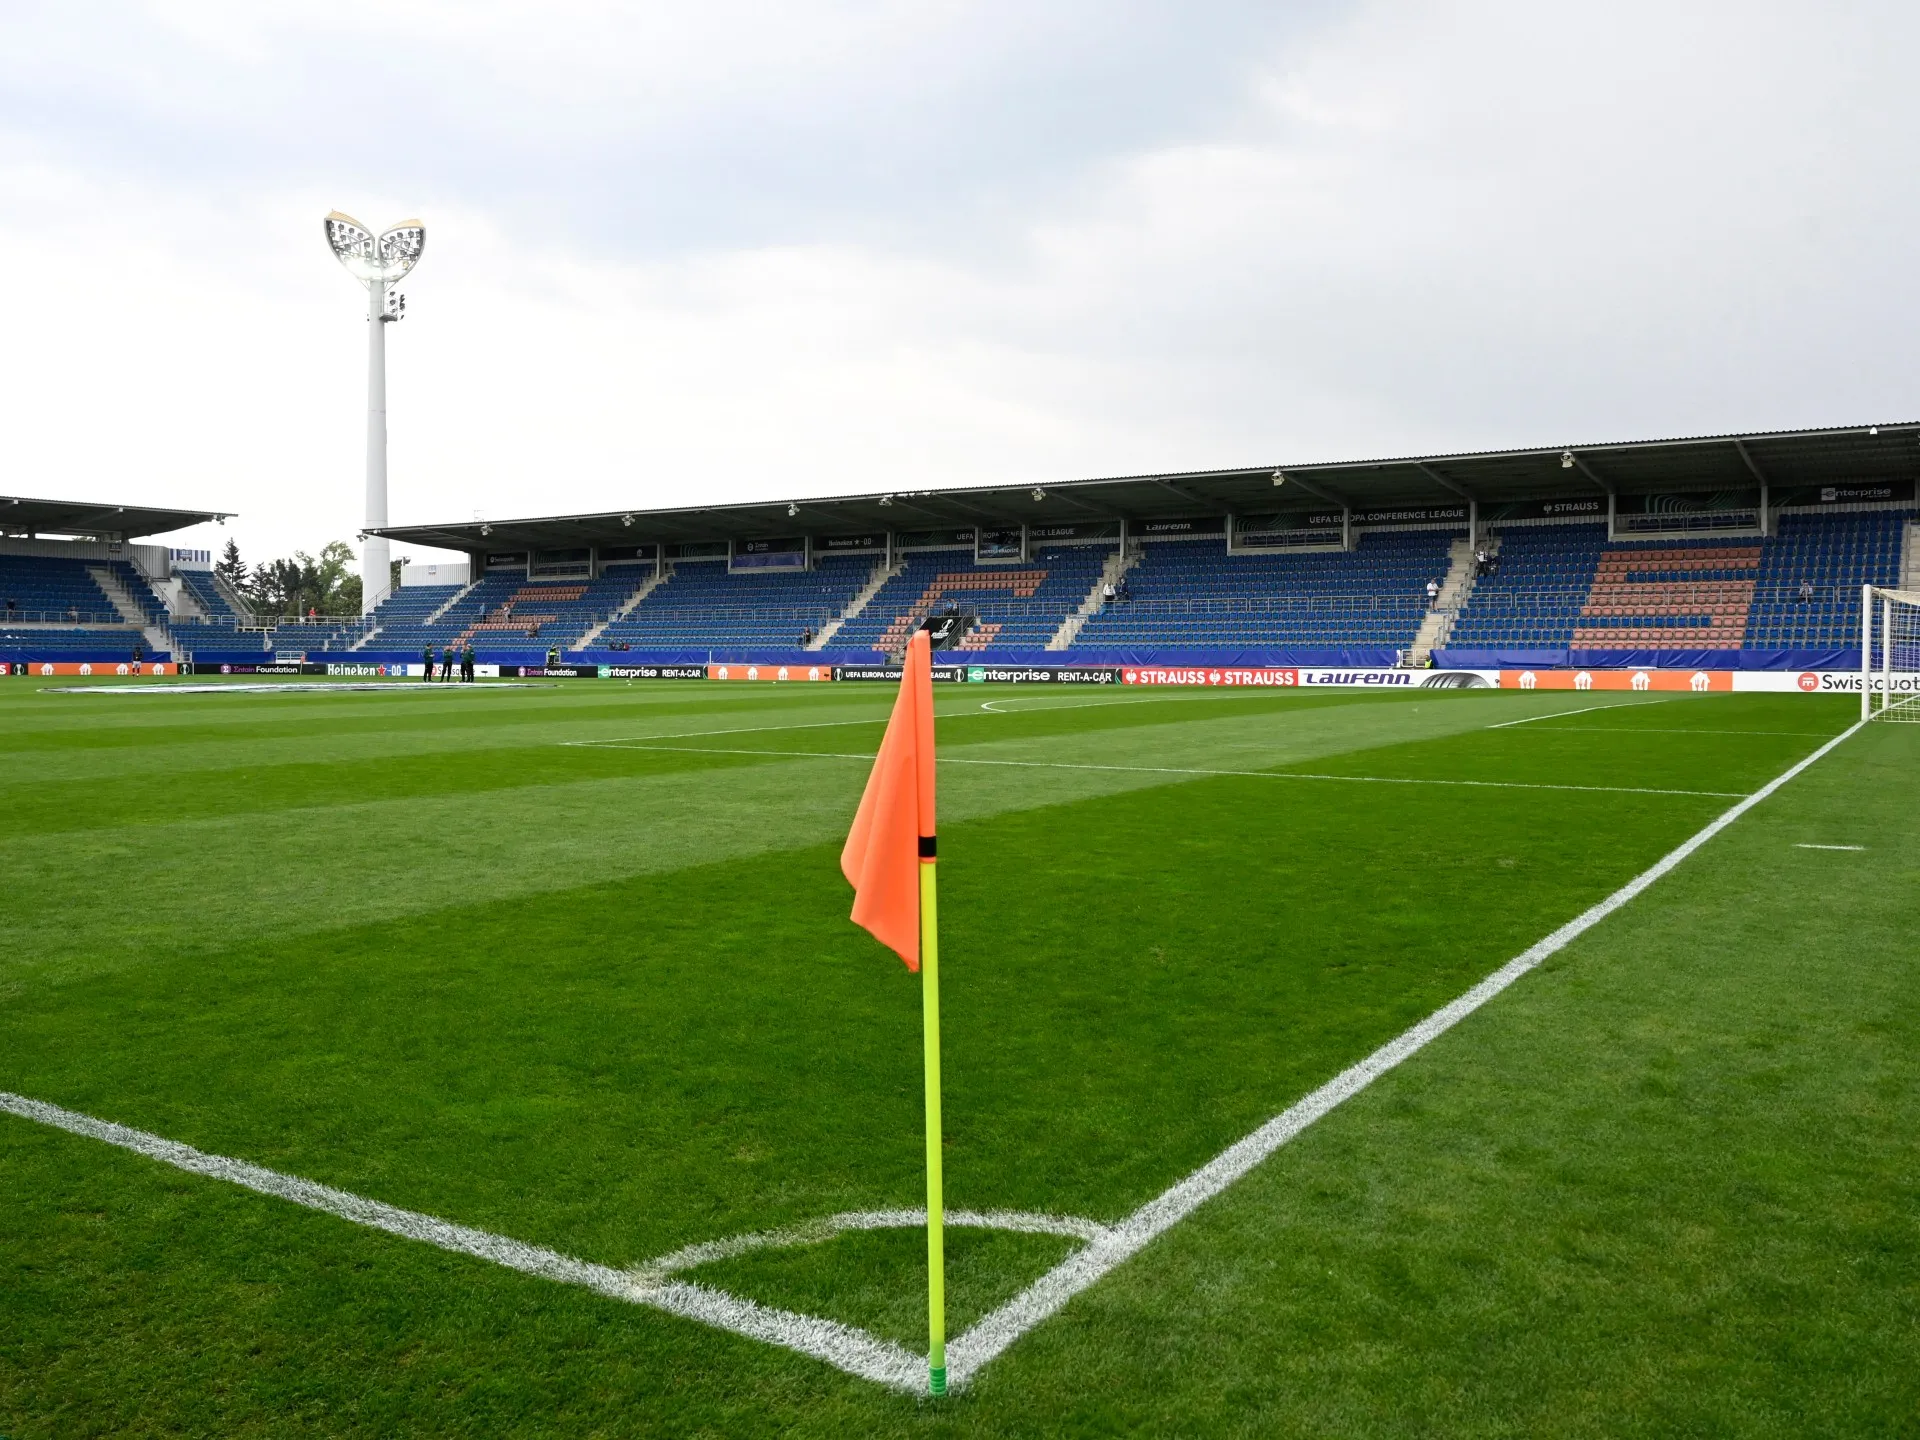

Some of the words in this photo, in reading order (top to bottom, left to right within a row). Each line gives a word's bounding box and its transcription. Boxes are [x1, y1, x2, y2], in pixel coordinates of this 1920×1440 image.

[1554, 502, 1599, 512] STRAUSS
[1309, 515, 1332, 524] UEFA
[1333, 514, 1366, 523] EUOPA
[1367, 511, 1426, 521] CONFERENCE
[1429, 509, 1465, 518] LEAGUE
[1047, 528, 1075, 536] LEAGUE
[255, 665, 298, 674] Foundation
[327, 664, 376, 676] Heineken
[543, 668, 578, 677] Foundation
[599, 667, 658, 679] enterprise
[661, 668, 701, 678] RENT-A-CAR
[845, 671, 861, 679] UEFA
[861, 671, 885, 679] EUROPA
[930, 671, 952, 679] EAGUE
[969, 668, 1051, 683] enterprise
[1057, 672, 1112, 682] RENT-A-CAR
[1139, 670, 1206, 684] STRAUSS
[1224, 671, 1294, 685] STRAUSS
